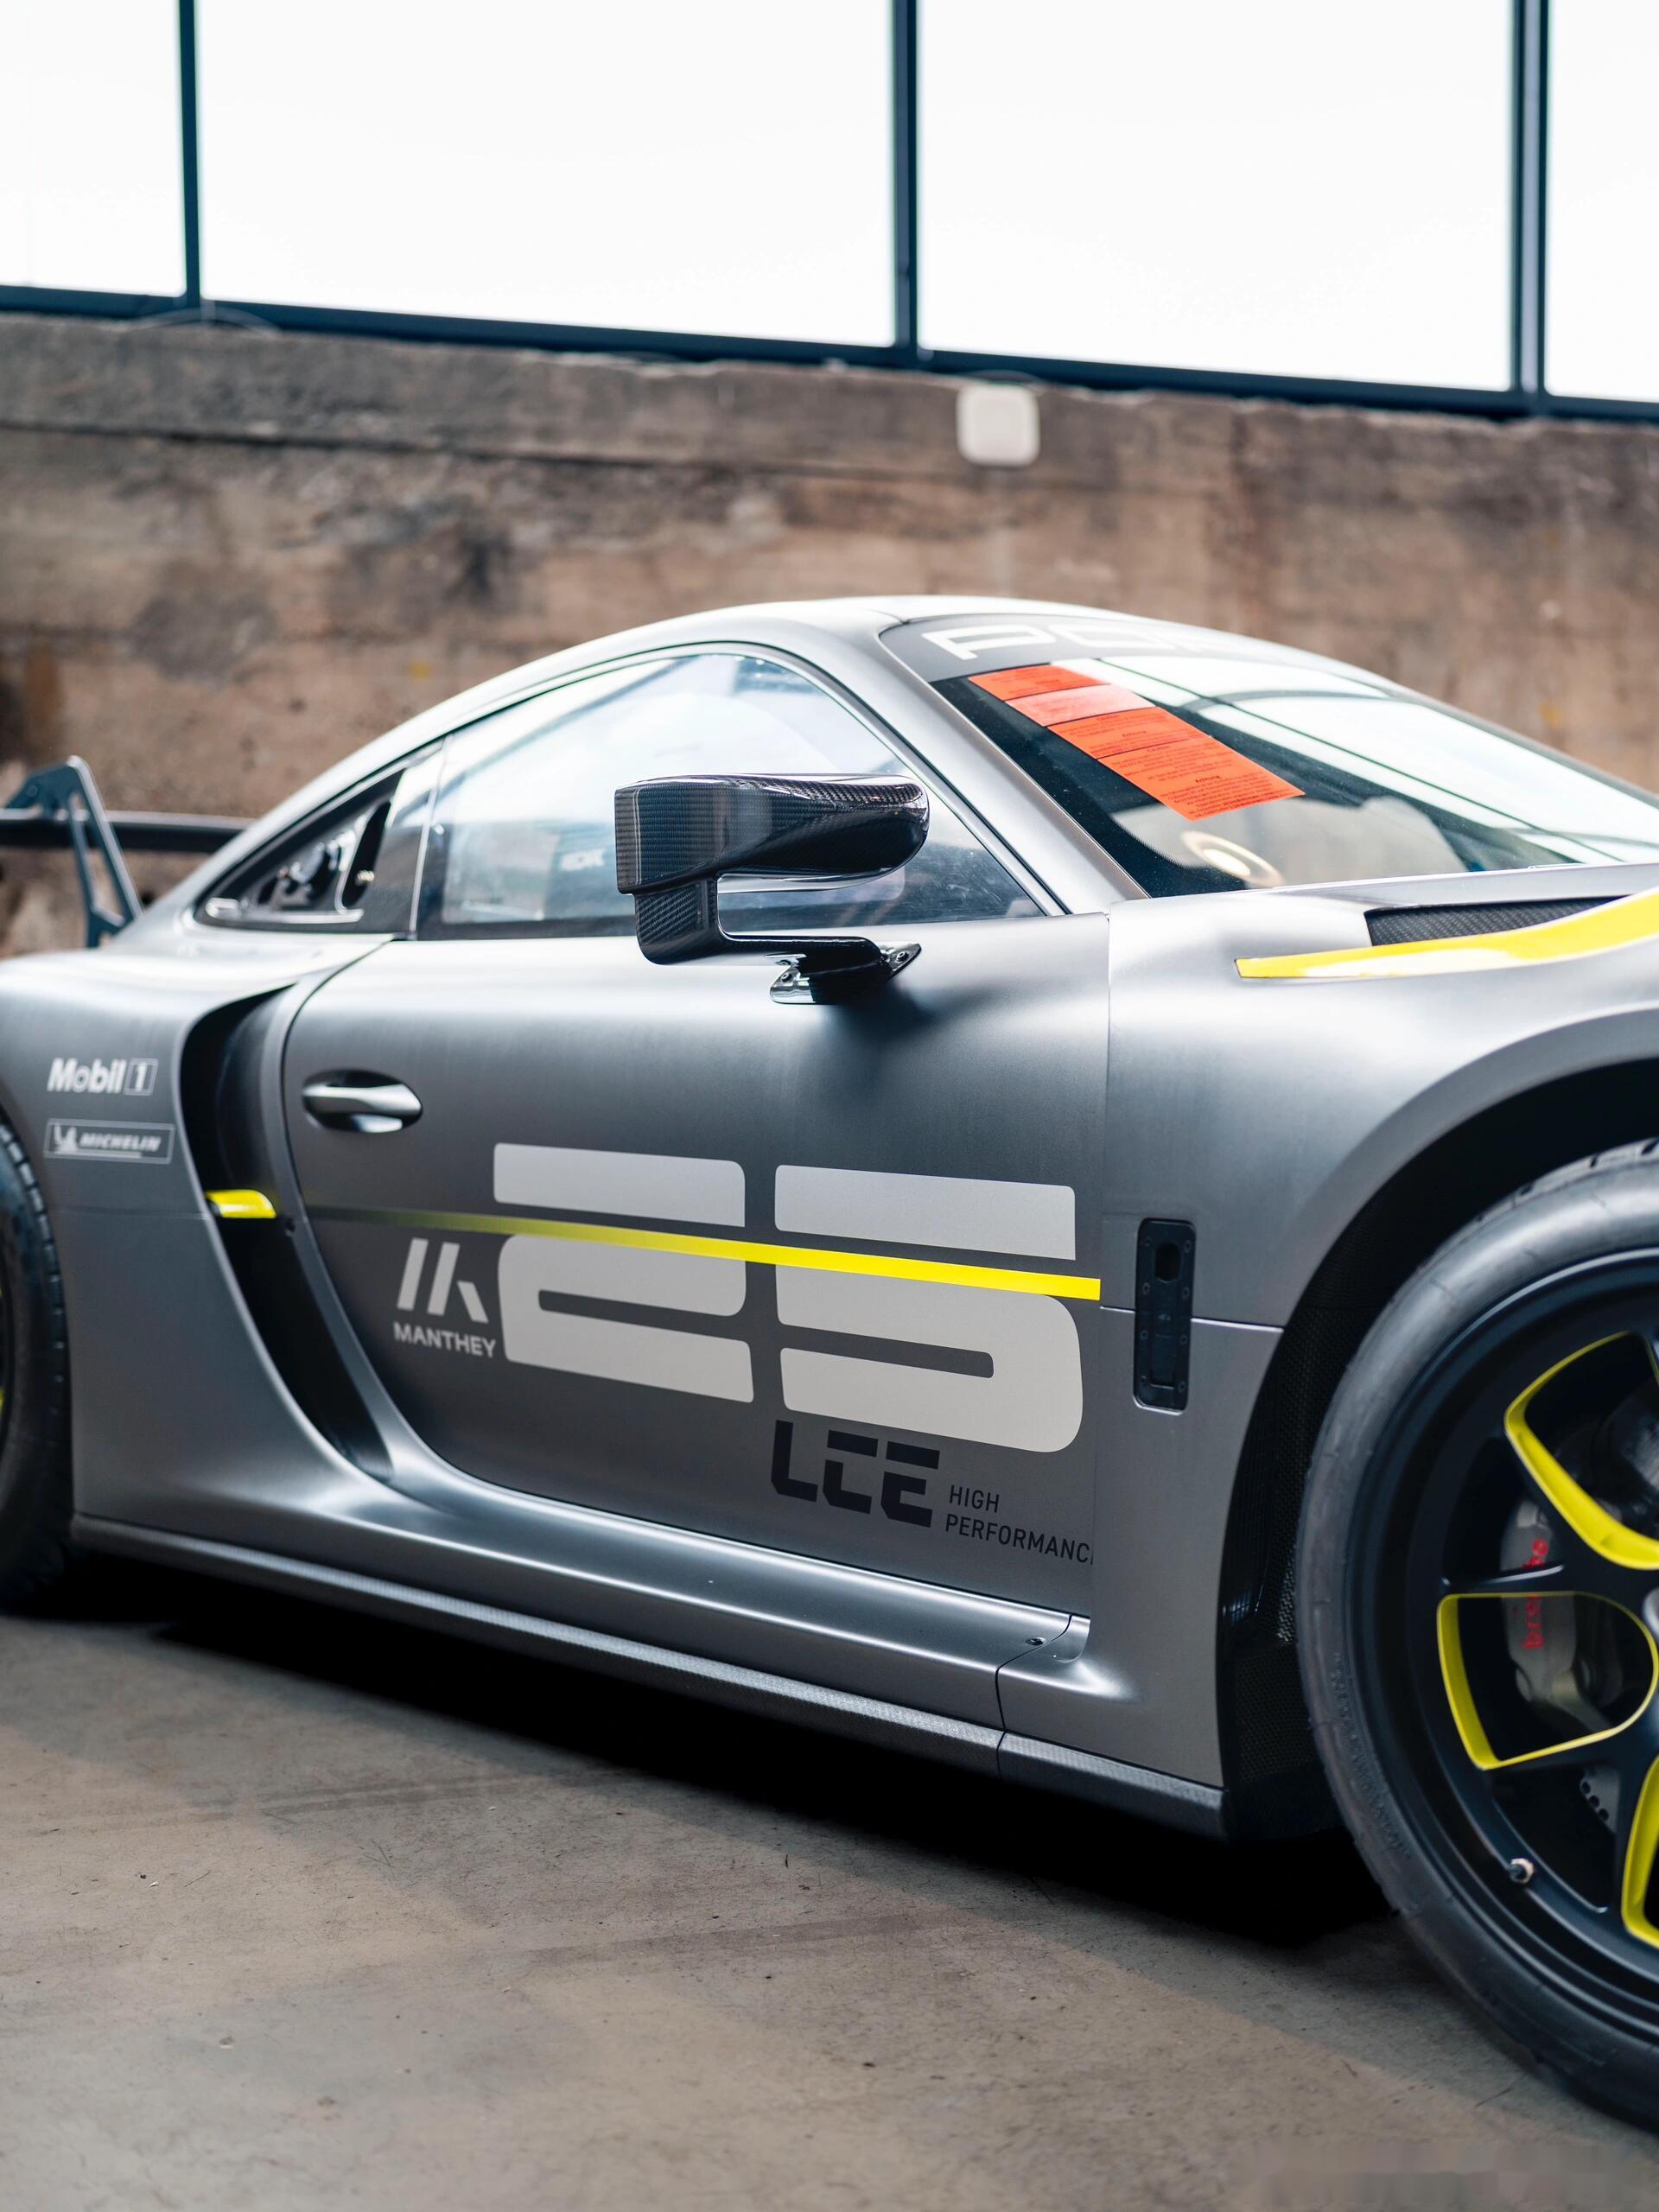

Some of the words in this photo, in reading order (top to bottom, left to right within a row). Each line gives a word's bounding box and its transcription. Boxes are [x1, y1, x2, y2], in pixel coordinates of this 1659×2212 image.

[47, 1058, 127, 1094] Mobil
[493, 1142, 1084, 1453] 25
[393, 1321, 496, 1357] MANTHEY
[949, 1484, 1000, 1513] HIGH
[944, 1514, 1094, 1566] PERFORMANC
